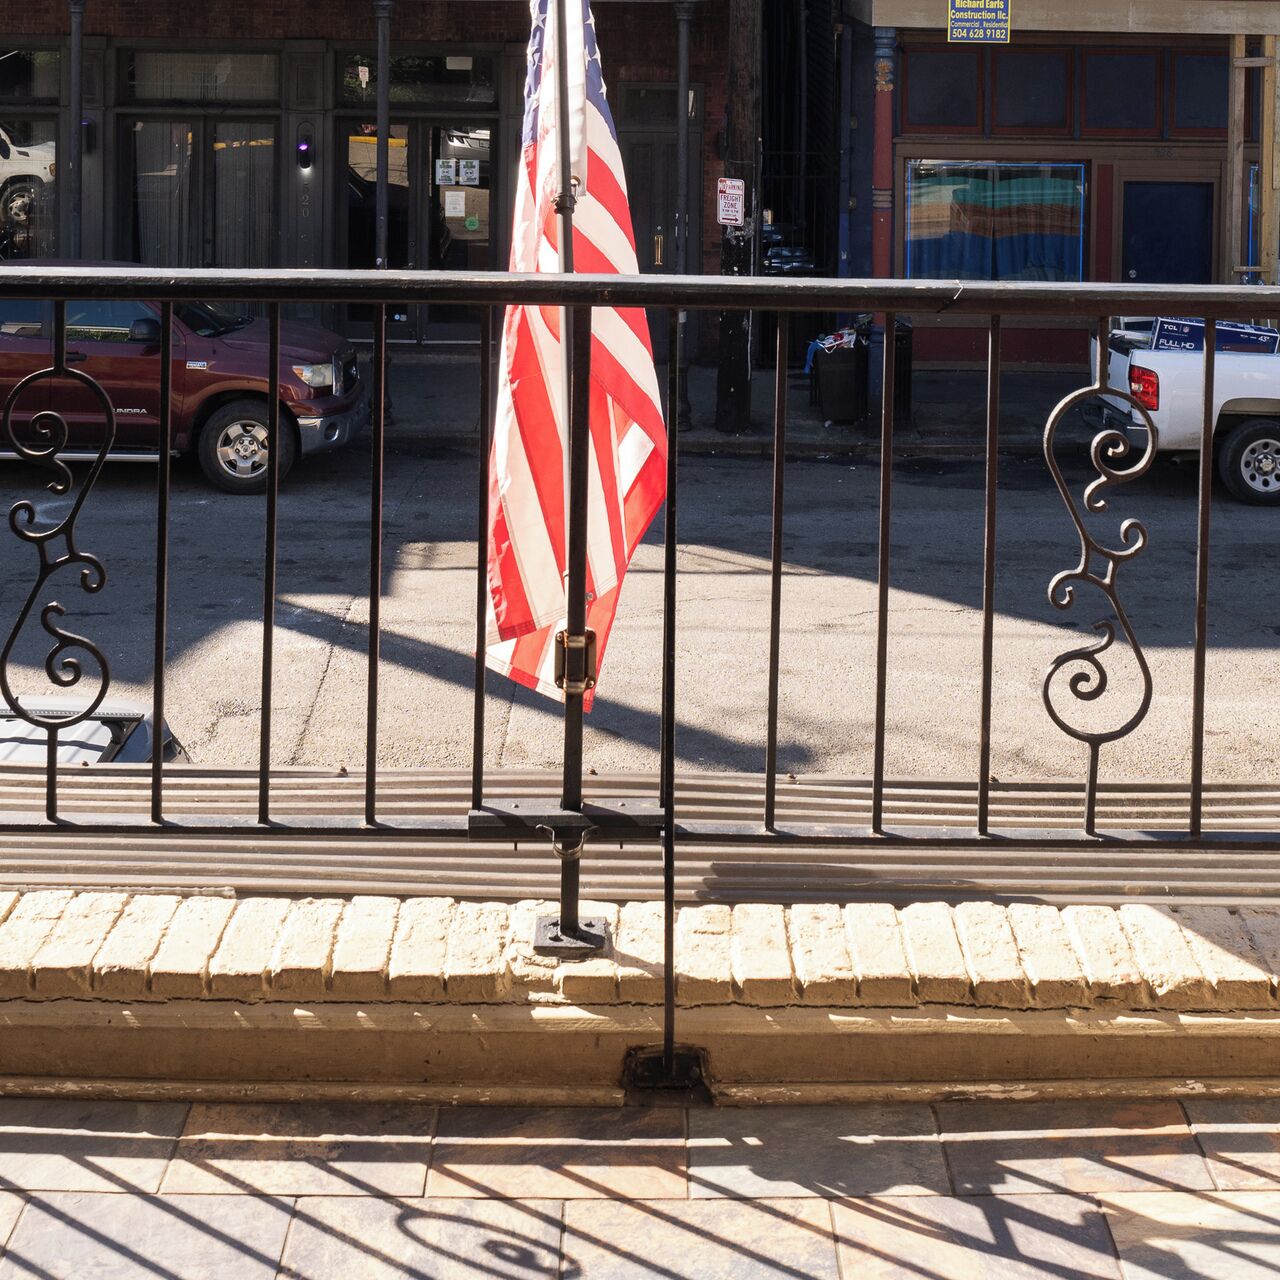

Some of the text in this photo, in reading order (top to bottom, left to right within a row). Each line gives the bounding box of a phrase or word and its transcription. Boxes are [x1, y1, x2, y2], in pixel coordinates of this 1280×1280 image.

[955, 0, 1004, 9] Richard Earls
[950, 10, 996, 20] Construction
[952, 29, 1006, 39] 504 628 9182
[1163, 323, 1178, 332] TCL
[1159, 338, 1181, 348] FULL
[1180, 341, 1195, 350] HD
